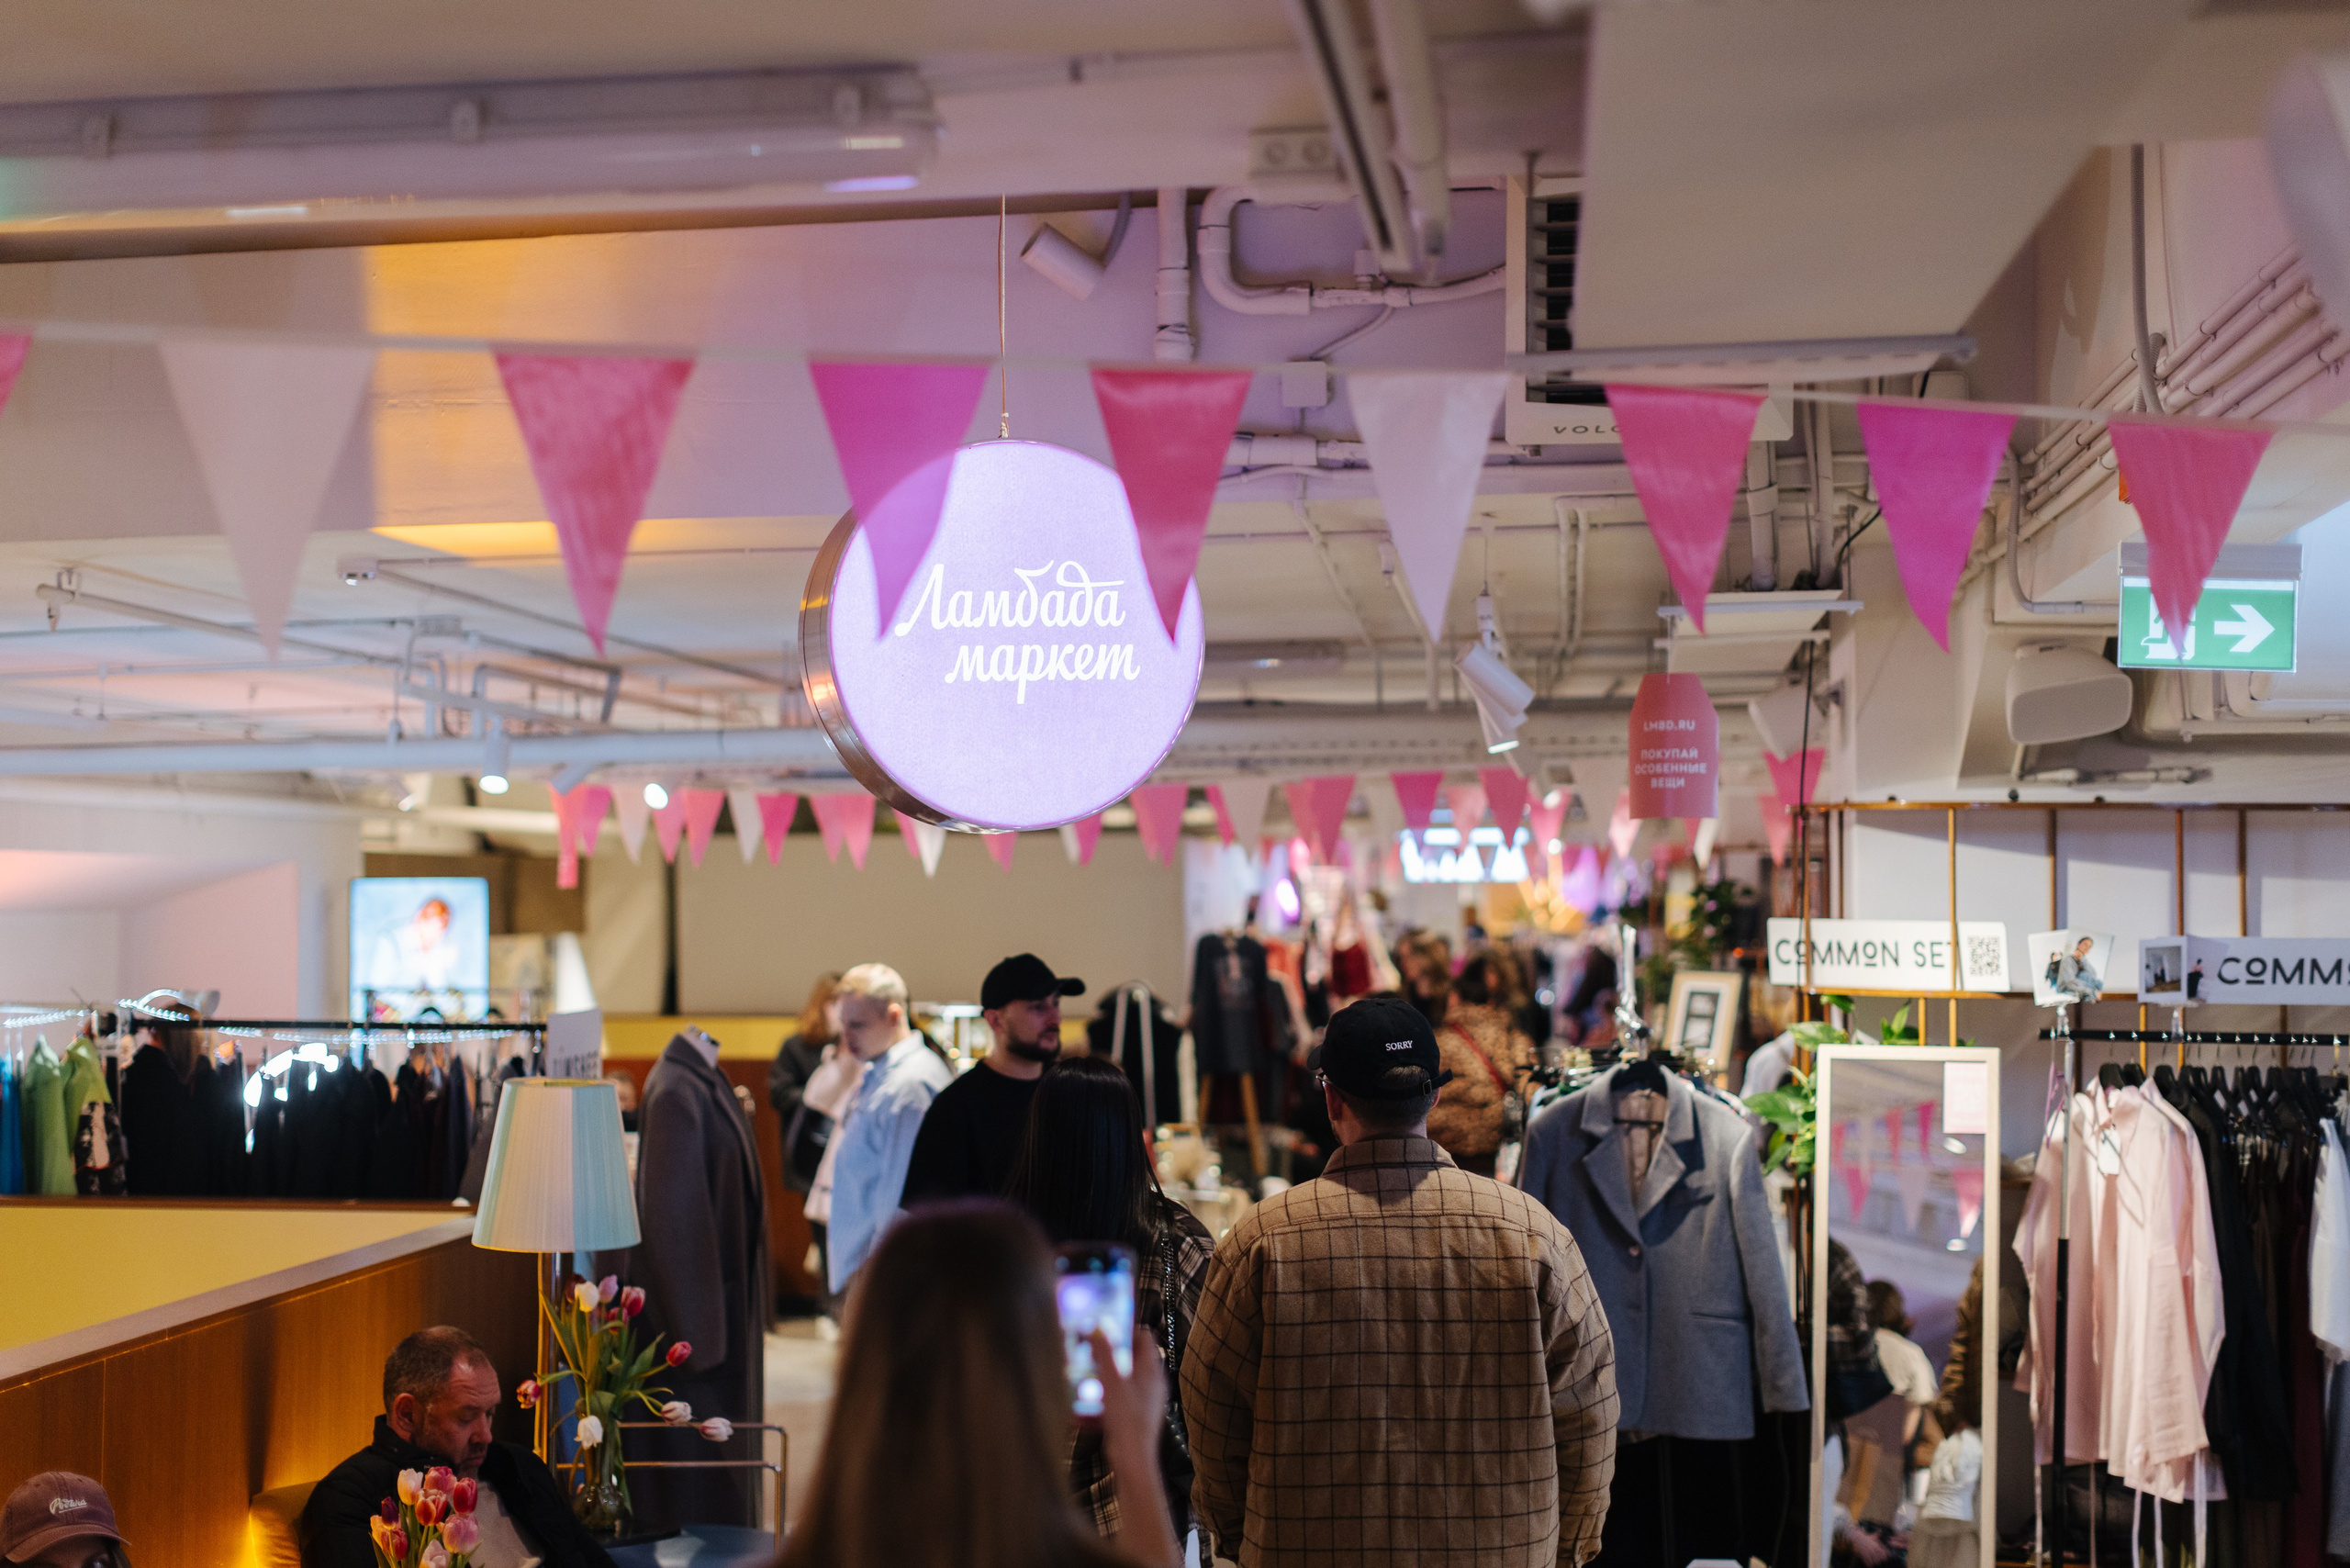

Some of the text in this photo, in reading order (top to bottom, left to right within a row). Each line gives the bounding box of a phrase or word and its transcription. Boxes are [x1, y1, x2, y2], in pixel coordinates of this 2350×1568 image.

[894, 560, 1125, 637] Ламбада
[945, 644, 1140, 705] маркет
[1641, 746, 1697, 759] ПОКУПАЙ
[1635, 763, 1707, 775] ОСОБЕННЫЕ
[1651, 778, 1685, 789] ВЕЩИ
[1775, 939, 1899, 968] COMMON
[2217, 957, 2350, 986] COMM
[1386, 1040, 1413, 1051] SORRY
